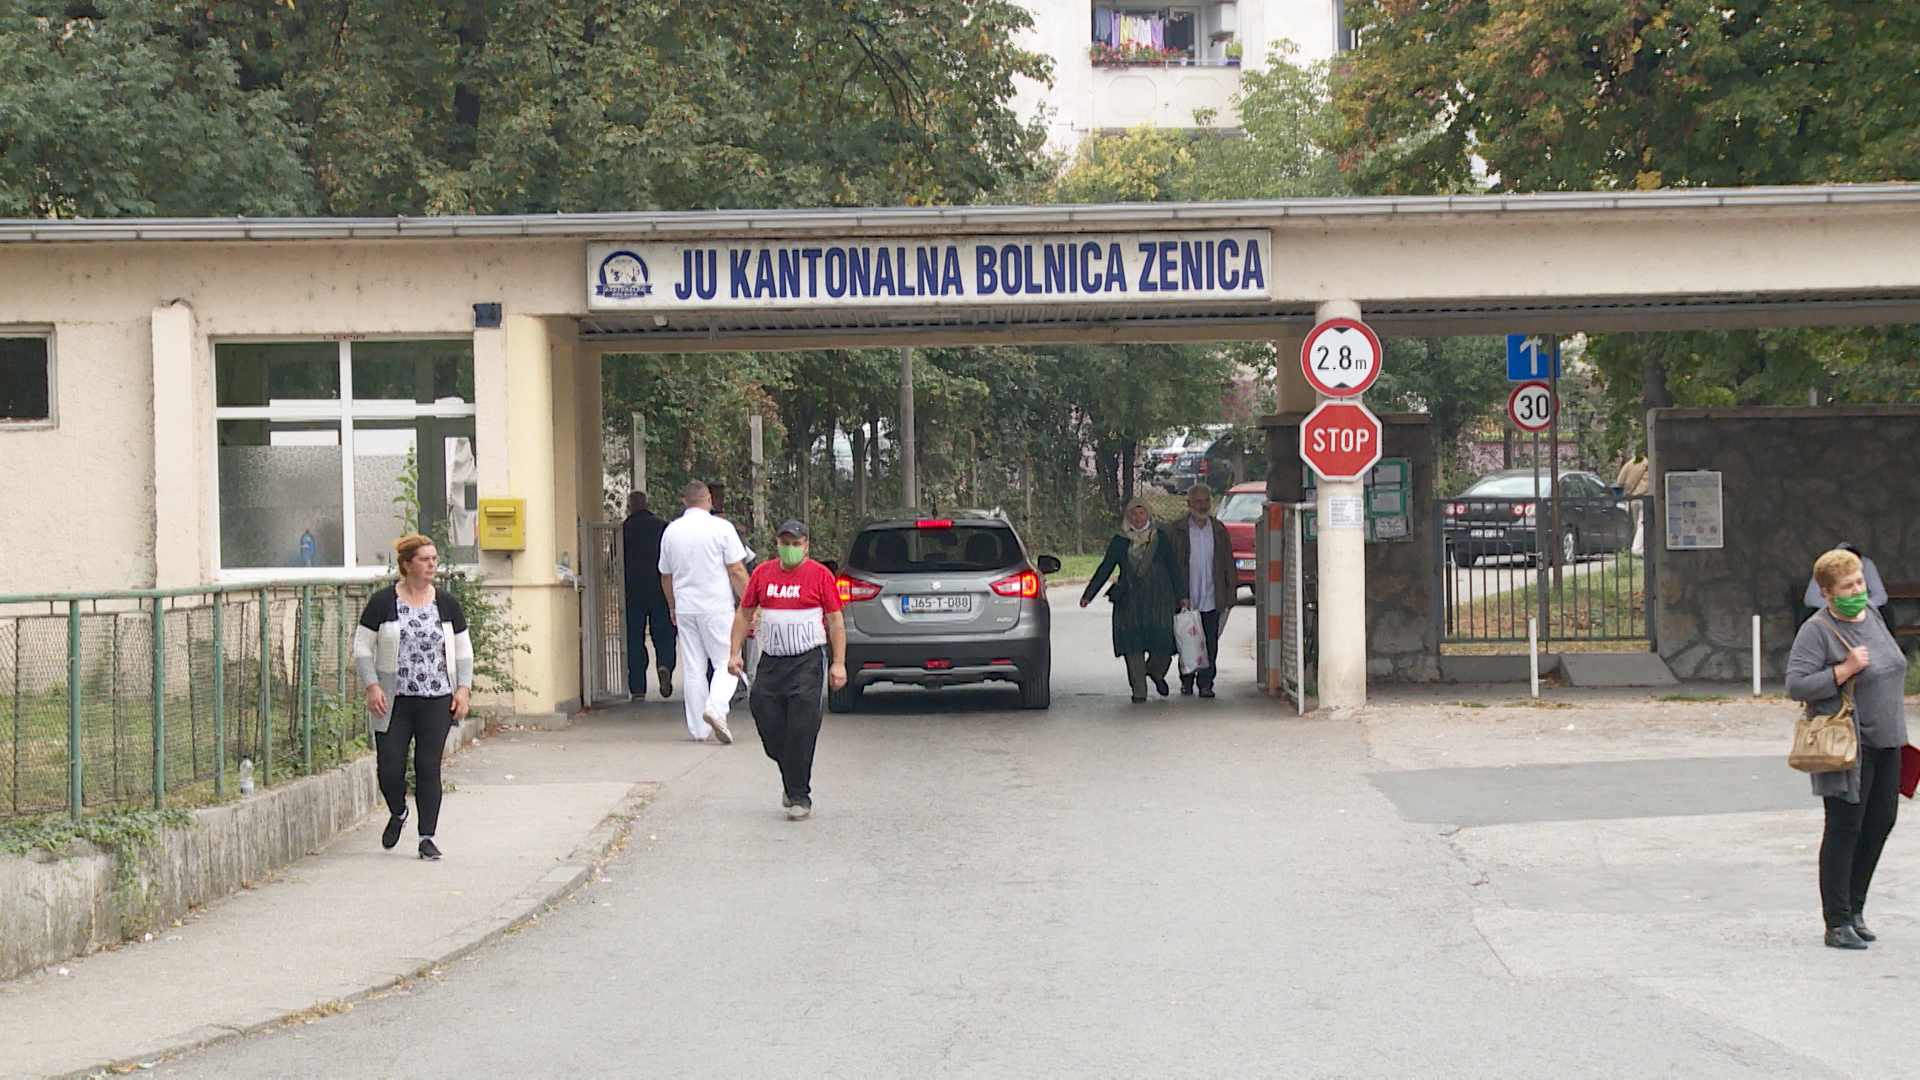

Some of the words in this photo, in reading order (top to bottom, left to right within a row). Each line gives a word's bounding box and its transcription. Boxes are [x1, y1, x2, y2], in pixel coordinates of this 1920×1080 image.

[674, 250, 717, 300] JU
[730, 246, 963, 300] KANTONALNA
[975, 243, 1127, 296] BOLNICA
[1139, 240, 1264, 291] ZENICA
[1520, 394, 1549, 420] 30
[1313, 427, 1370, 452] STOP
[766, 583, 801, 598] BLACK
